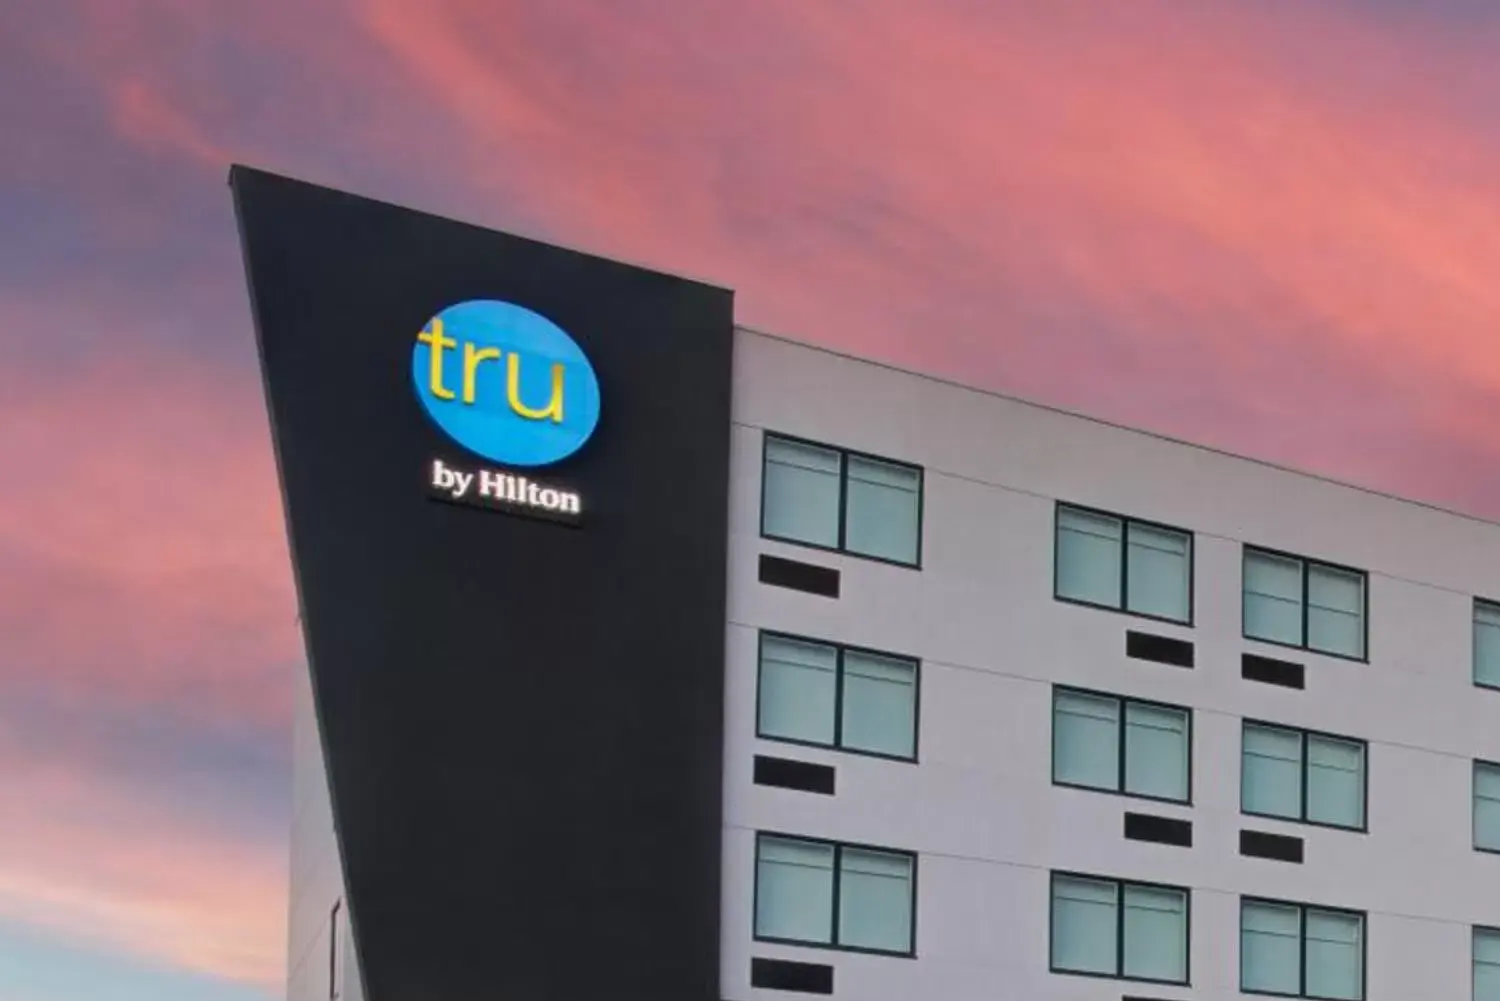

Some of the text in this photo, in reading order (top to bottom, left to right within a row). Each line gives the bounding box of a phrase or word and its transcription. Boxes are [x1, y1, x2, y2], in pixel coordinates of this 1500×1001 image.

[417, 317, 565, 422] tru
[432, 459, 580, 513] by Hilton
